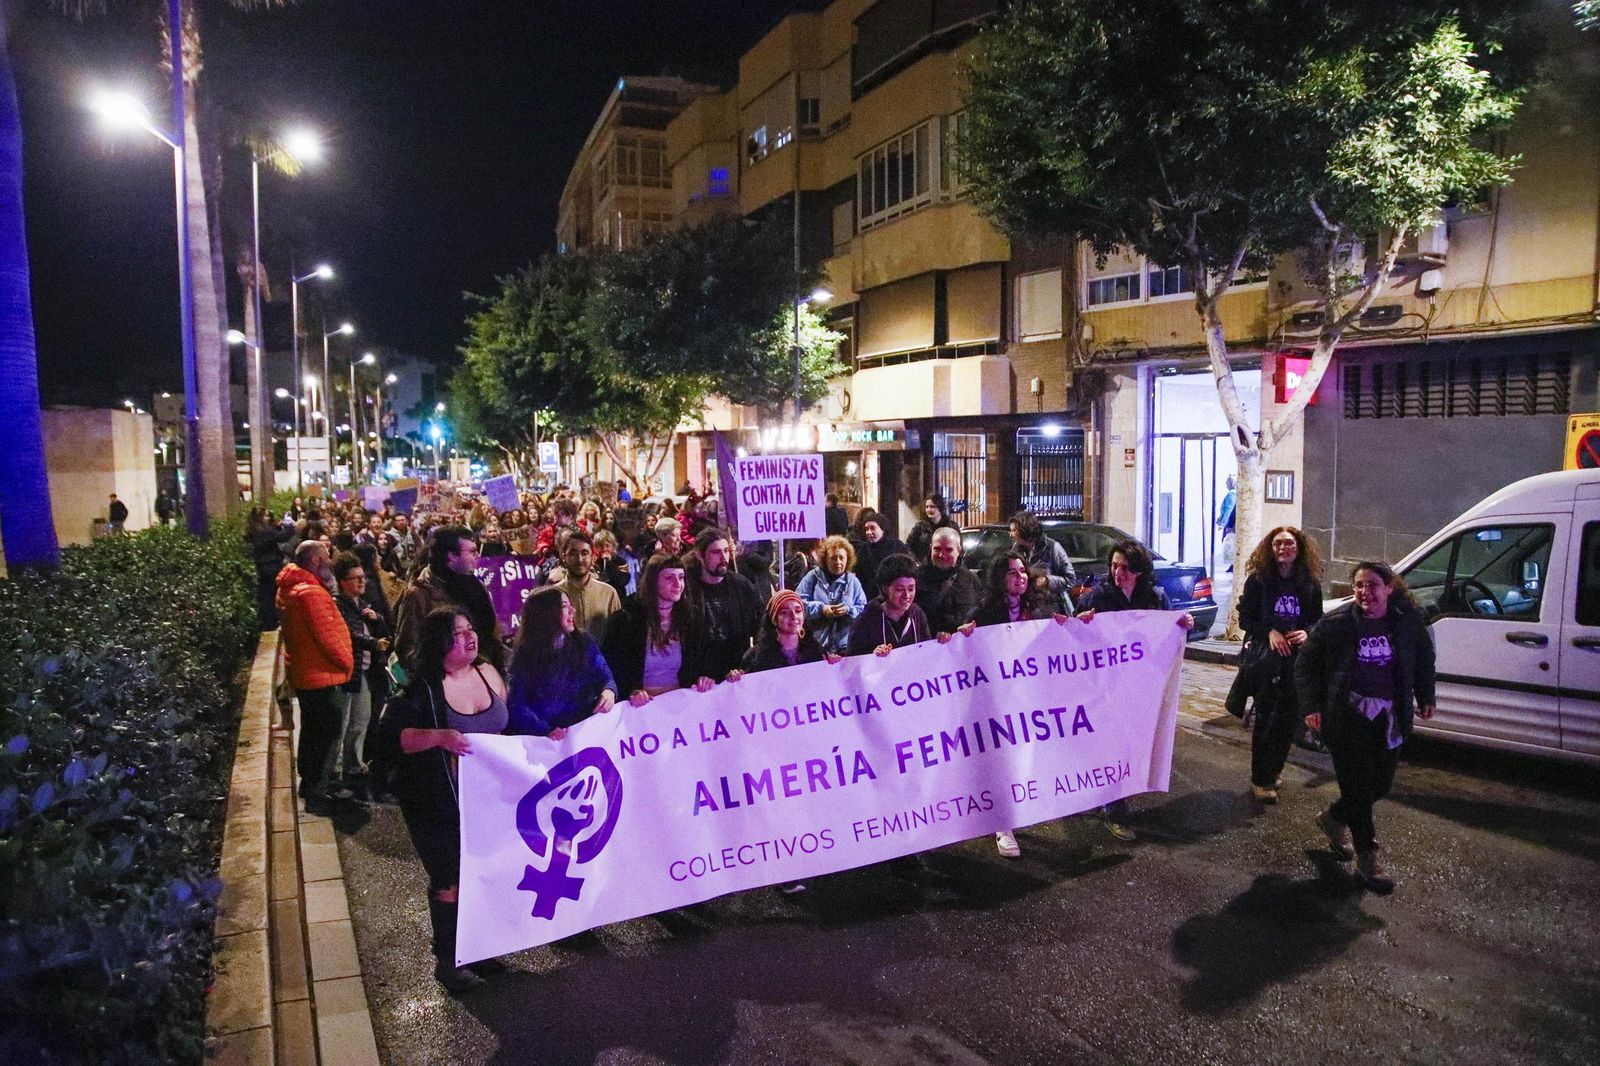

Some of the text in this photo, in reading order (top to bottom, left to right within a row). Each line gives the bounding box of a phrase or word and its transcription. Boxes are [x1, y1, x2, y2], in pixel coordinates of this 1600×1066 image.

[850, 430, 873, 442] ROCK
[876, 429, 896, 442] BAR
[739, 457, 819, 481] FEMINISTAS
[742, 483, 815, 507] CONTRA LA
[755, 510, 807, 534] GUERRA
[619, 641, 1145, 760] NO A LA VIOLENCIA CONTRA LAS MUJERES
[692, 704, 1095, 817] ALMERÍA FEMINISTA
[668, 828, 836, 882] COLECTIVOS
[852, 791, 995, 843] FEMINISTAS
[1010, 780, 1038, 803] DE
